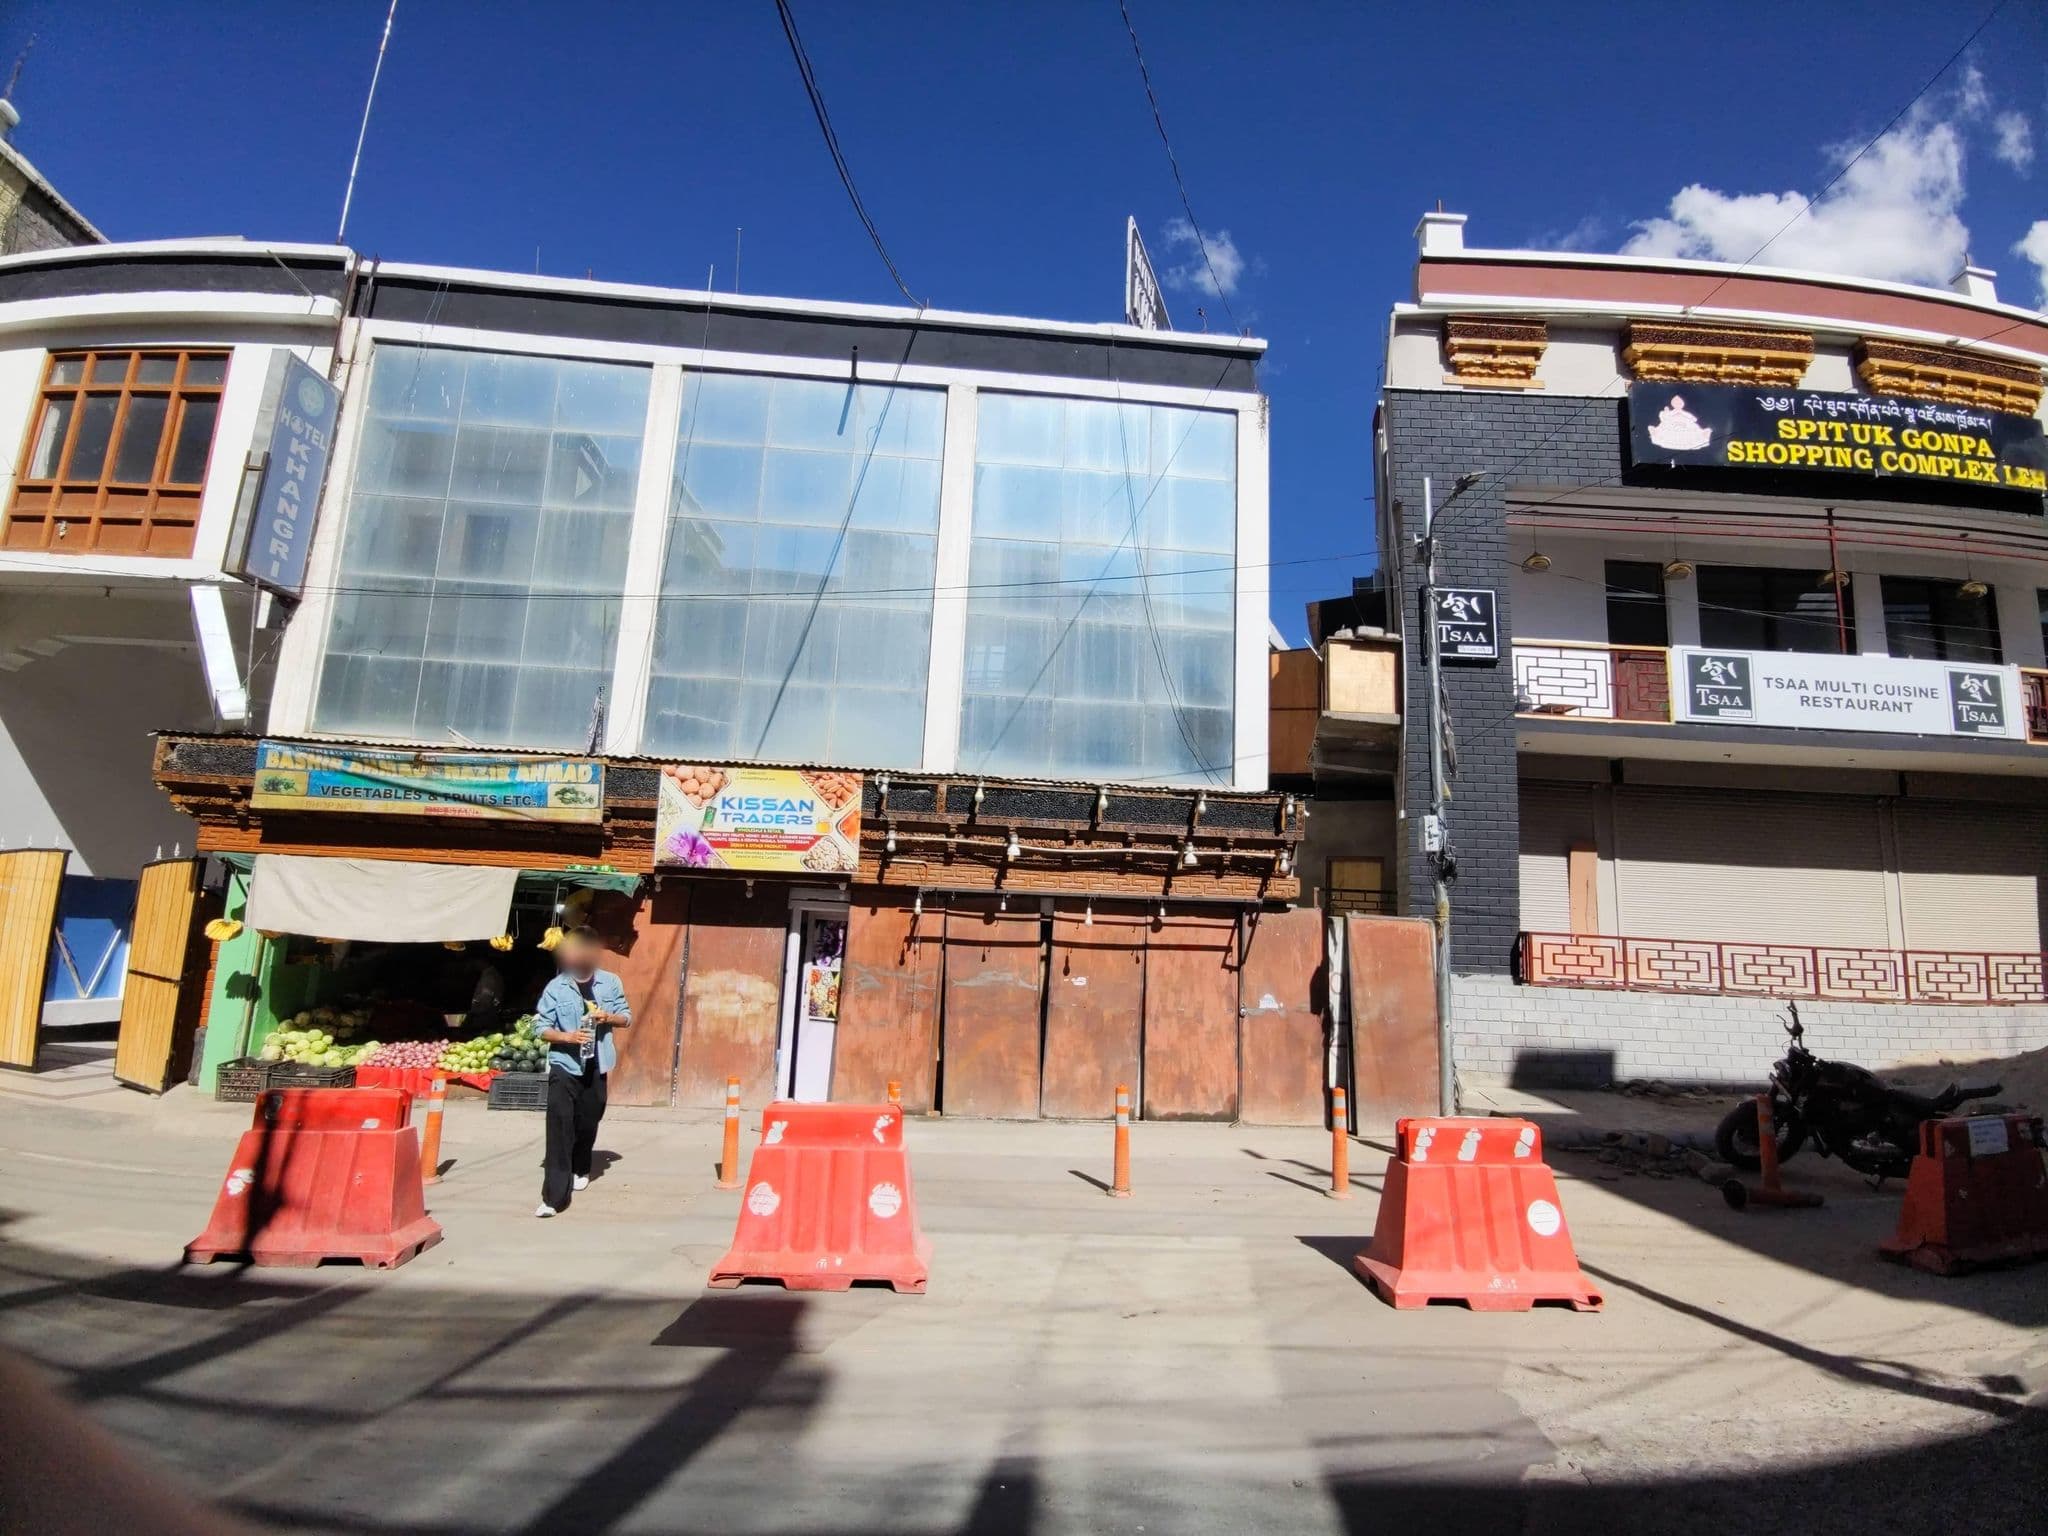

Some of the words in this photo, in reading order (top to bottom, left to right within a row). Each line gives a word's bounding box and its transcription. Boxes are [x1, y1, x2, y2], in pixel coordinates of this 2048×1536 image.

[1778, 418, 1896, 447] SPITUK
[1902, 428, 1996, 459] GONPA
[1727, 440, 1873, 469] SHOPPING
[1881, 450, 2000, 483] COMPLEX
[269, 437, 311, 577] KHANGRI
[1763, 677, 1809, 690] TSAA
[1815, 680, 1867, 694] MULTI
[1873, 684, 1940, 699] CUISINE
[1800, 695, 1913, 713] RESTAURANT
[320, 785, 422, 801] VEGETABLES
[427, 792, 438, 802] &
[443, 792, 498, 806] FRUITS
[721, 797, 815, 813] KISSAN
[720, 812, 814, 826] TRADERS
